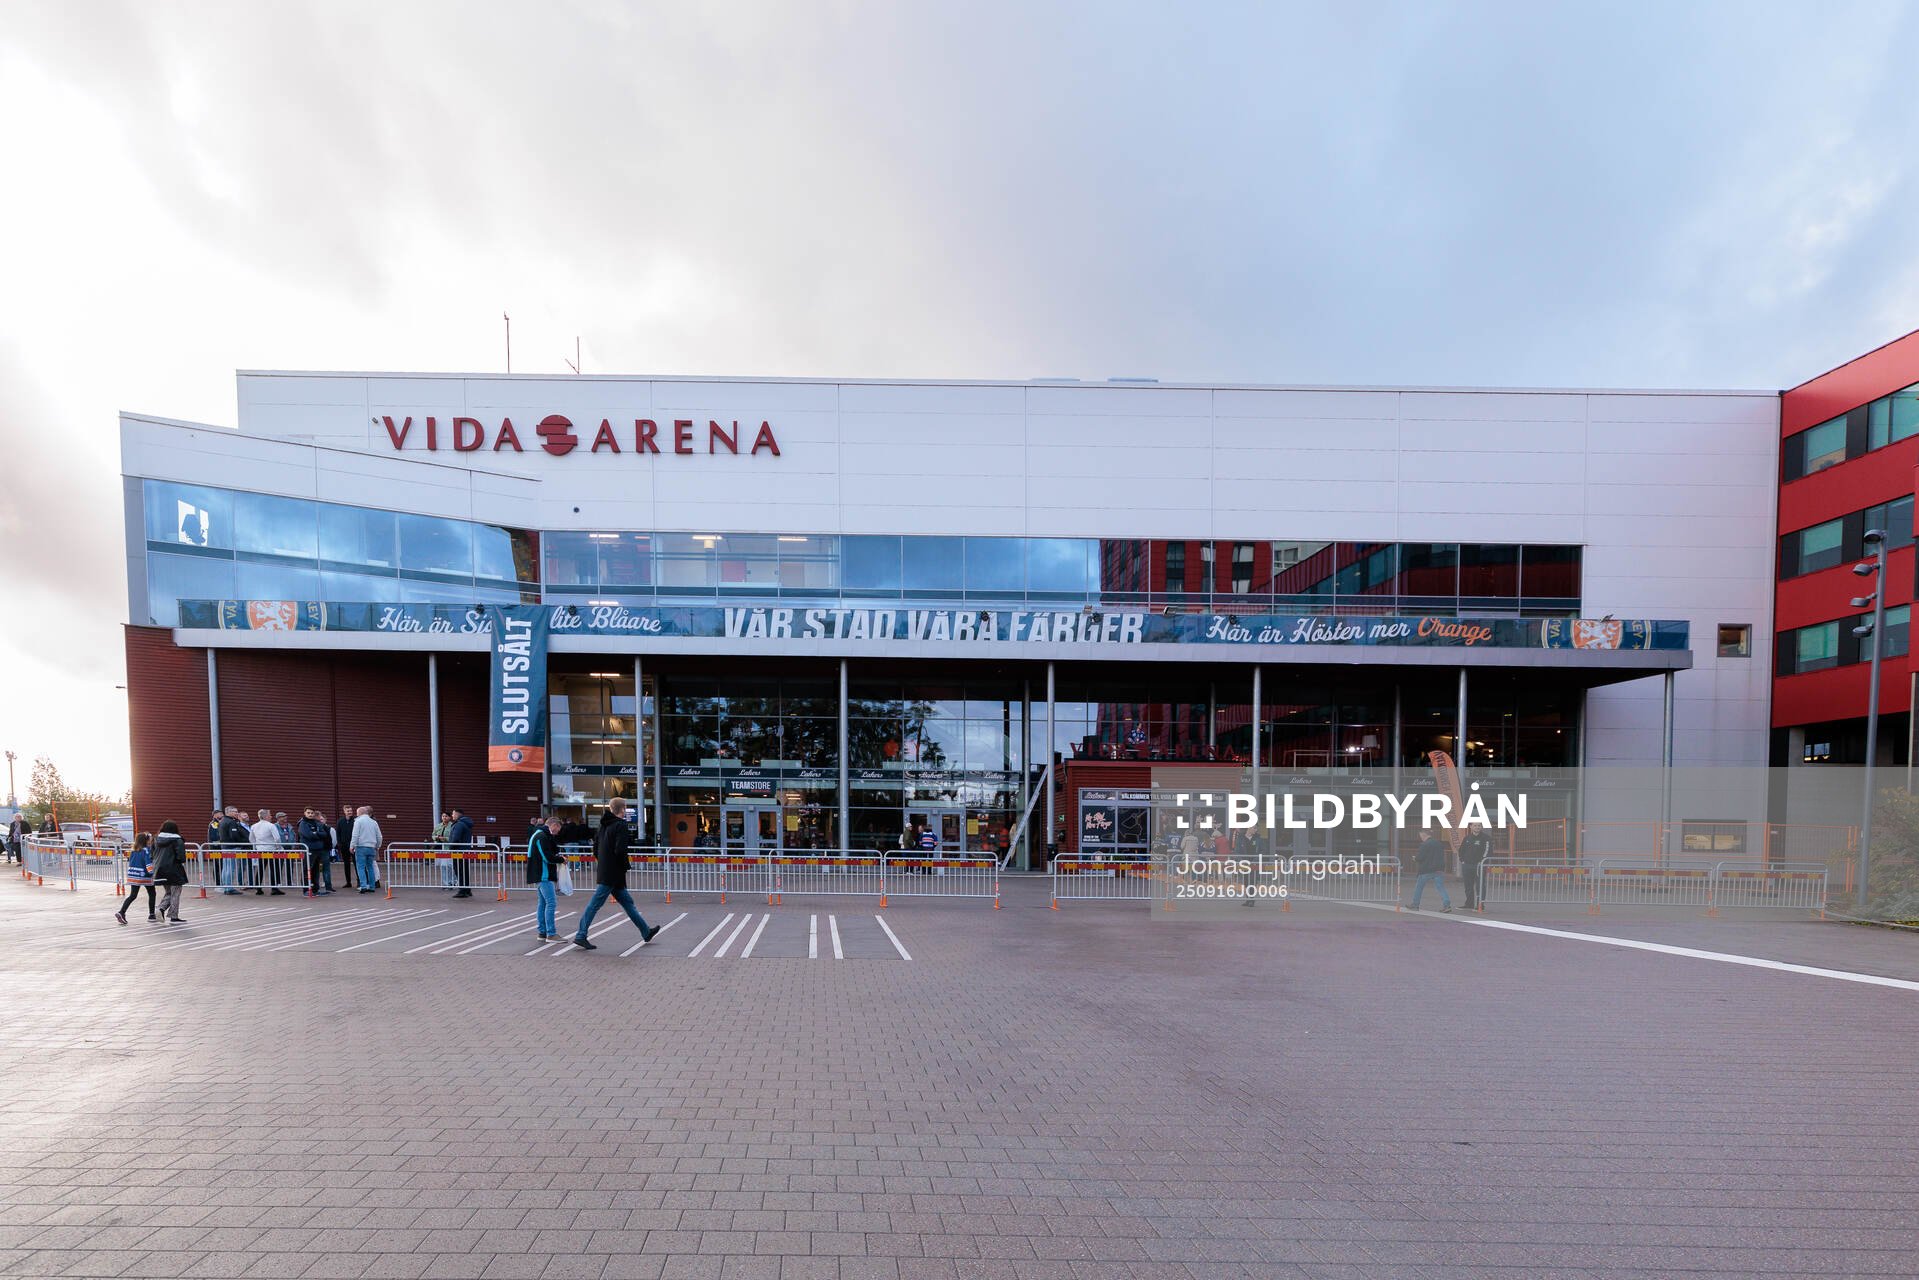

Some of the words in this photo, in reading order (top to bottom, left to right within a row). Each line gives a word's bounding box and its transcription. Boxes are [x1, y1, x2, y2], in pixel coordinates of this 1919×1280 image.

[382, 416, 524, 452] VIDA
[590, 418, 781, 456] ARENA
[377, 607, 423, 633] Här
[428, 617, 454, 633] är
[549, 606, 582, 629] lite
[588, 606, 661, 632] Blåare
[724, 608, 794, 638] VÅR
[803, 608, 897, 640] STAD
[907, 610, 998, 641] VÅRA
[1009, 611, 1144, 643] FÄRGER
[1206, 615, 1252, 641] Här
[1258, 626, 1284, 643] är
[1289, 617, 1365, 642] Hösten
[1369, 623, 1411, 639] mer
[1417, 616, 1492, 646] Orange
[498, 617, 532, 734] SLUTSÅLT
[738, 768, 761, 776] Lakers
